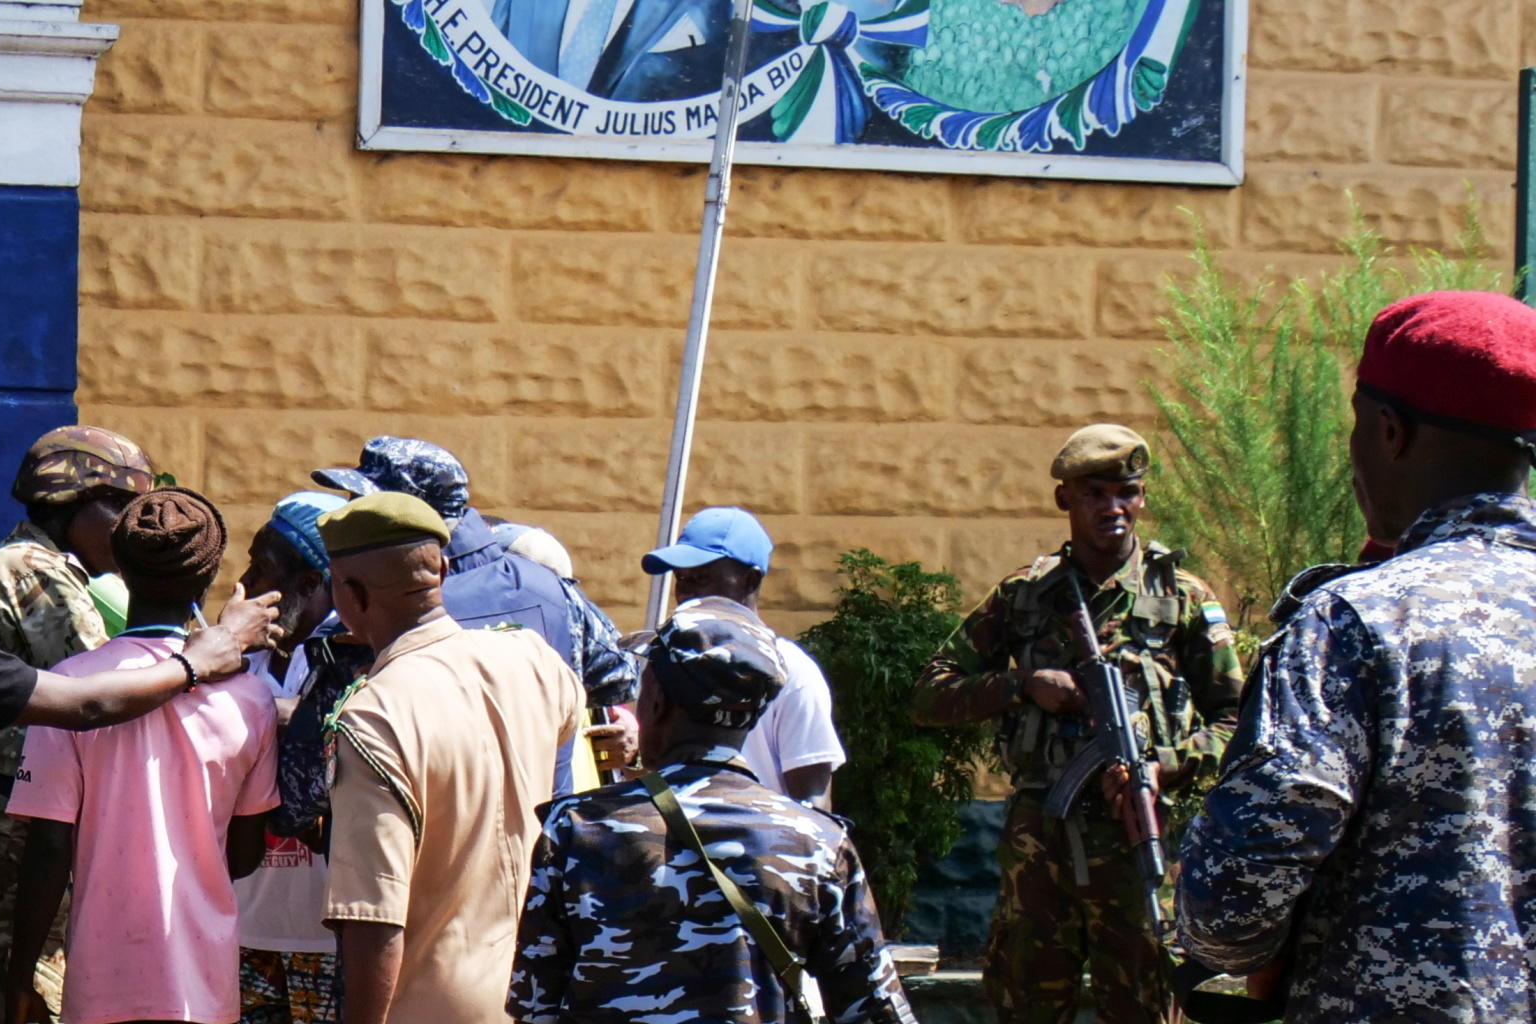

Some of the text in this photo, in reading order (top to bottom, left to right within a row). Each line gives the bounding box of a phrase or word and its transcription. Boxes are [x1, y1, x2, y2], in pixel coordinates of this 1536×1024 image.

[457, 30, 590, 130] PRESIDENT
[595, 110, 677, 136] JULIUS
[685, 83, 765, 131] MADA
[766, 51, 804, 91] BIO
